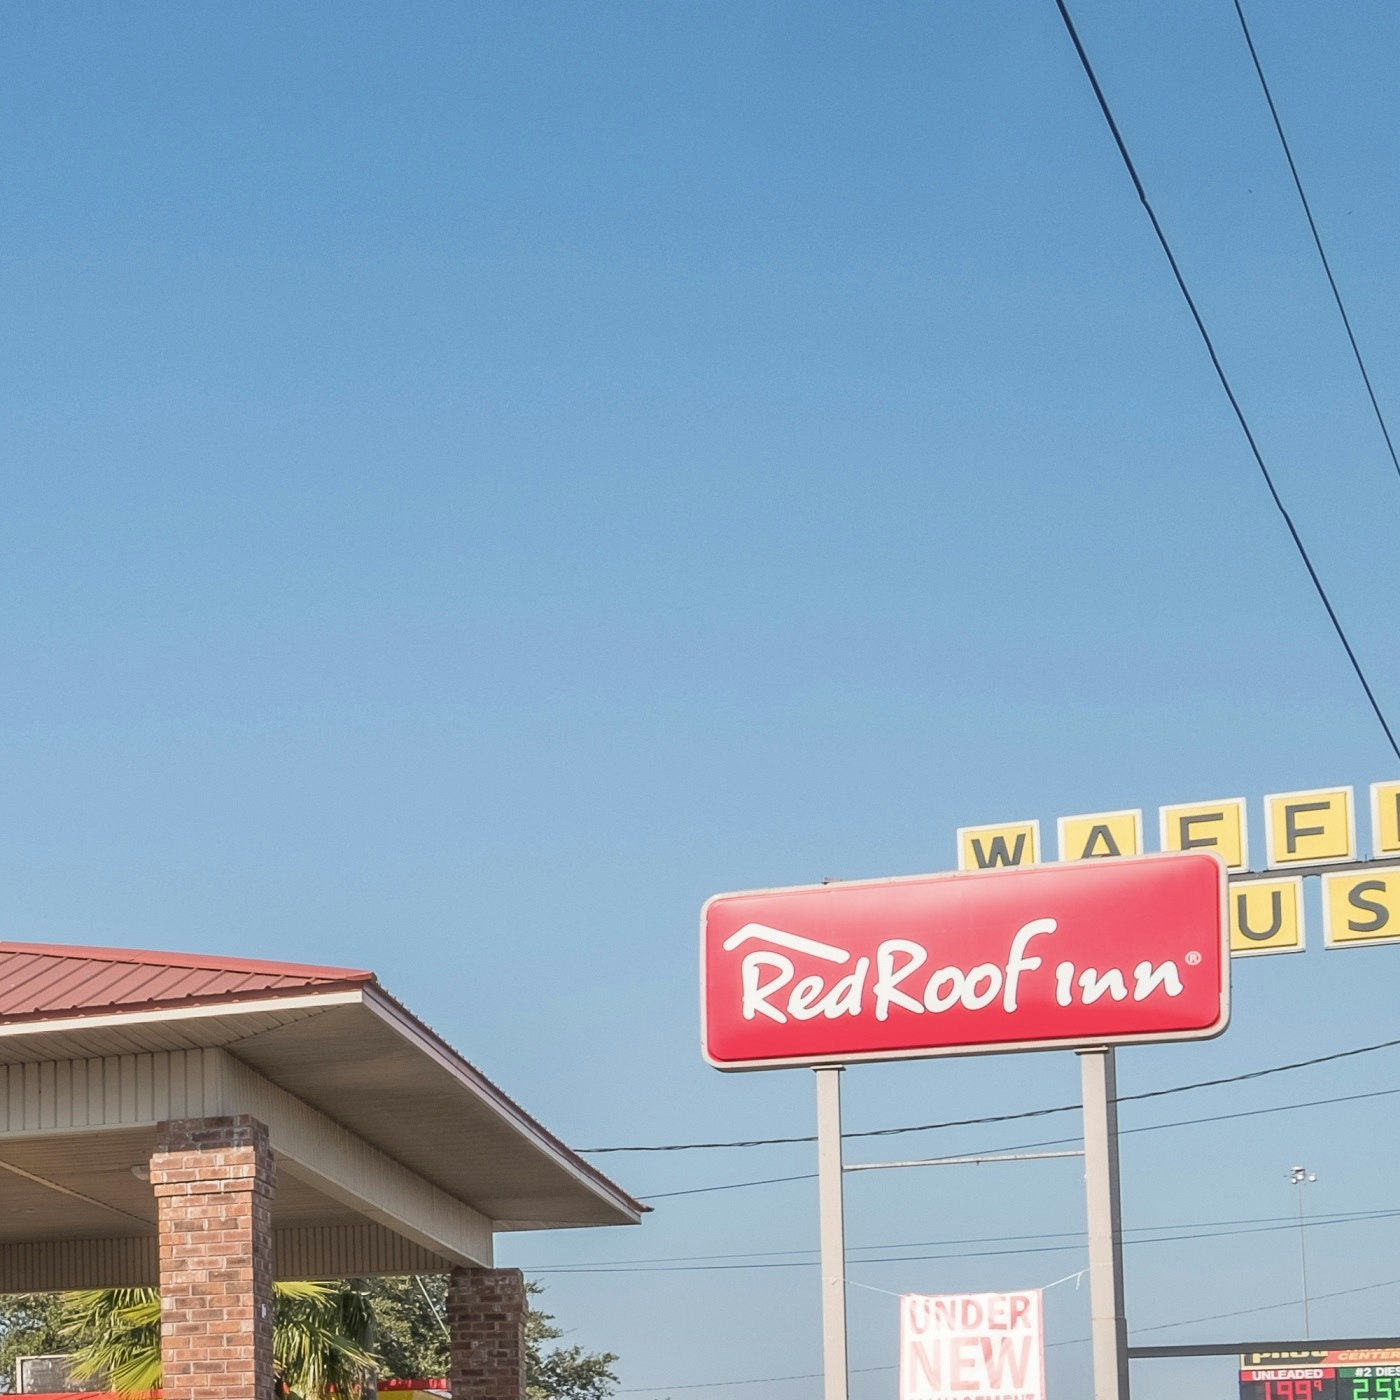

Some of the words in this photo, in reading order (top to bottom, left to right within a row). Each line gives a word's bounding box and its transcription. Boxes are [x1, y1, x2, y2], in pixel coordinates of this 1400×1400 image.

[971, 793, 1400, 869] WAFF
[910, 1295, 1032, 1334] UNDER
[910, 1335, 1033, 1393] NEW
[1251, 1368, 1324, 1381] UNLEADED
